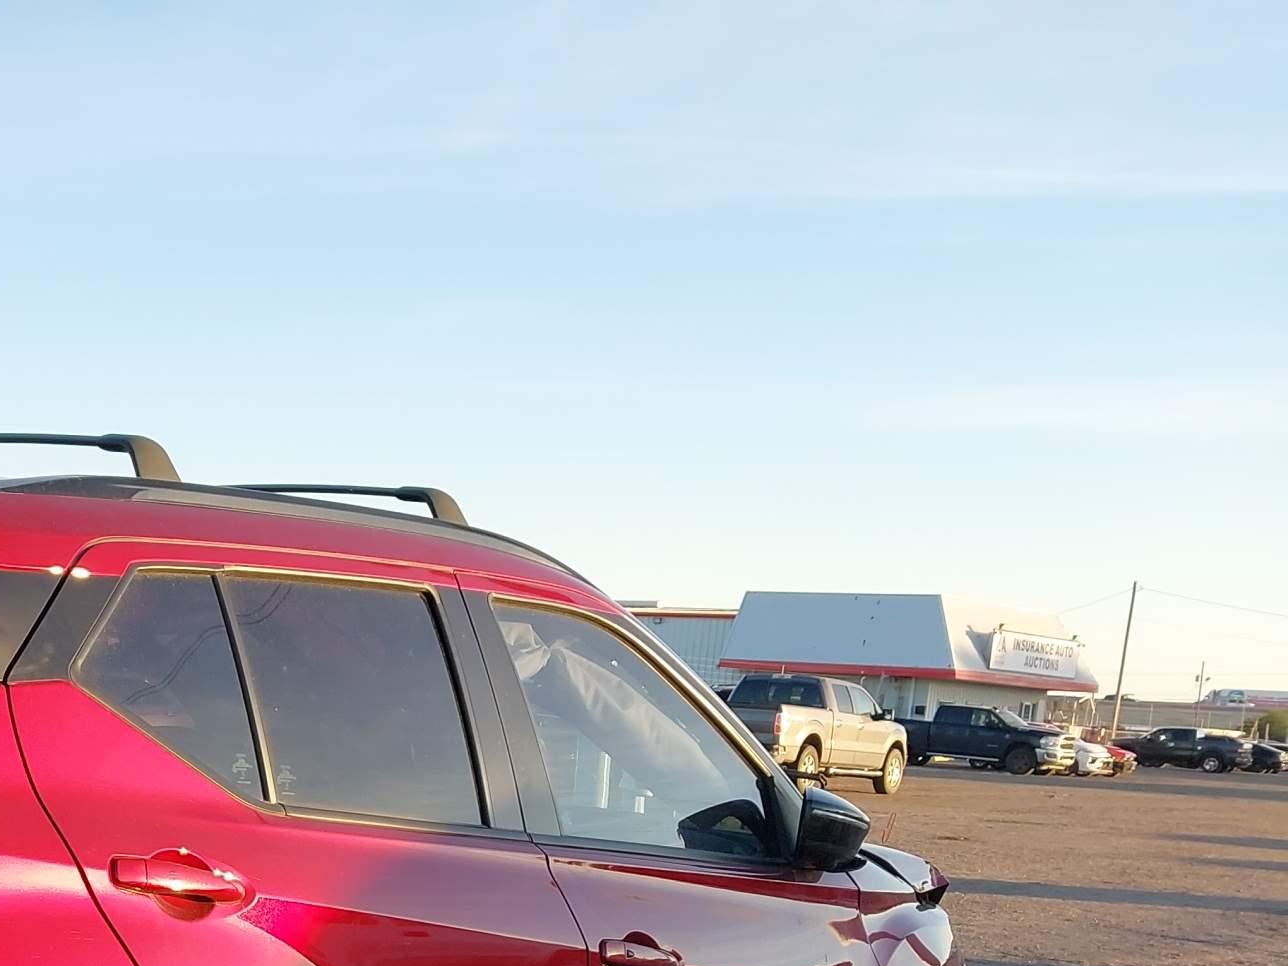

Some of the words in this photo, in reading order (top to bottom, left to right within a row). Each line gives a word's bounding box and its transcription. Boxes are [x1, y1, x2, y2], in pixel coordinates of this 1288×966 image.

[1012, 638, 1053, 656] INSURANCE
[1054, 642, 1073, 658] AUTO
[1023, 655, 1060, 671] AUCTIONS
